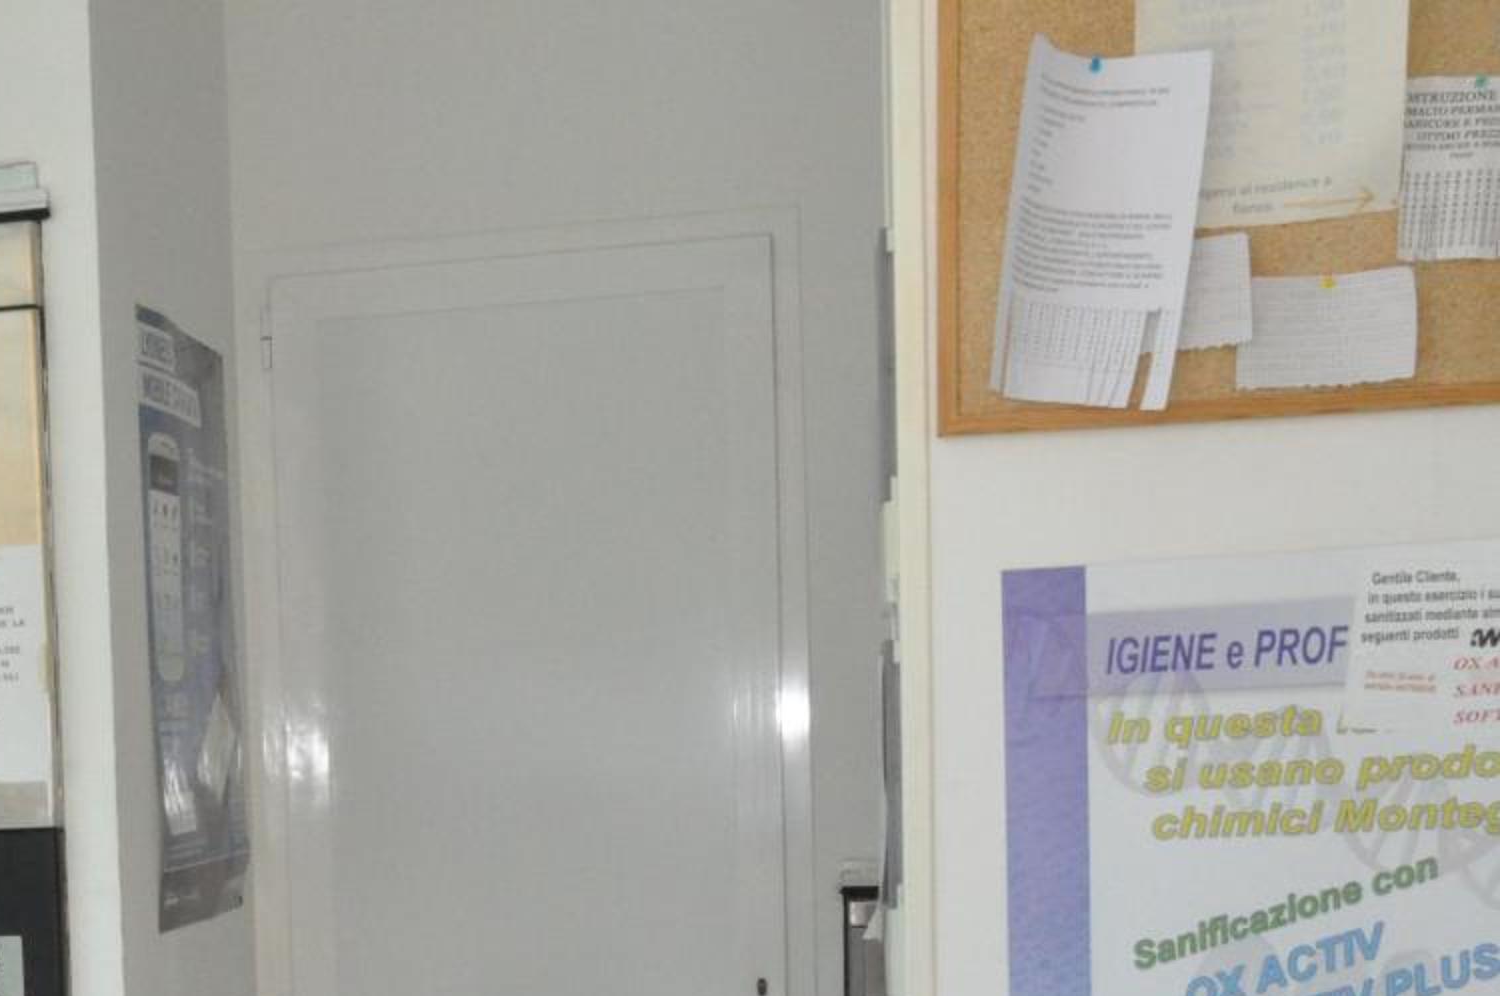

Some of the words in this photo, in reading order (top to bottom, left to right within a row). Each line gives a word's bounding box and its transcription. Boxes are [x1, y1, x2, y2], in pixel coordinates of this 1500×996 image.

[1371, 571, 1412, 586] Gentile
[1106, 632, 1218, 675] IGIENE
[1226, 639, 1245, 670] e
[1254, 624, 1350, 668] PROF
[1106, 709, 1152, 746] In
[1163, 704, 1324, 750] questa
[1143, 757, 1189, 794] si
[1197, 757, 1345, 791] usano
[1152, 802, 1326, 840] chimici
[1133, 881, 1362, 970] Sanificazione
[1372, 856, 1440, 896] con
[1256, 920, 1384, 995] ACTIV
